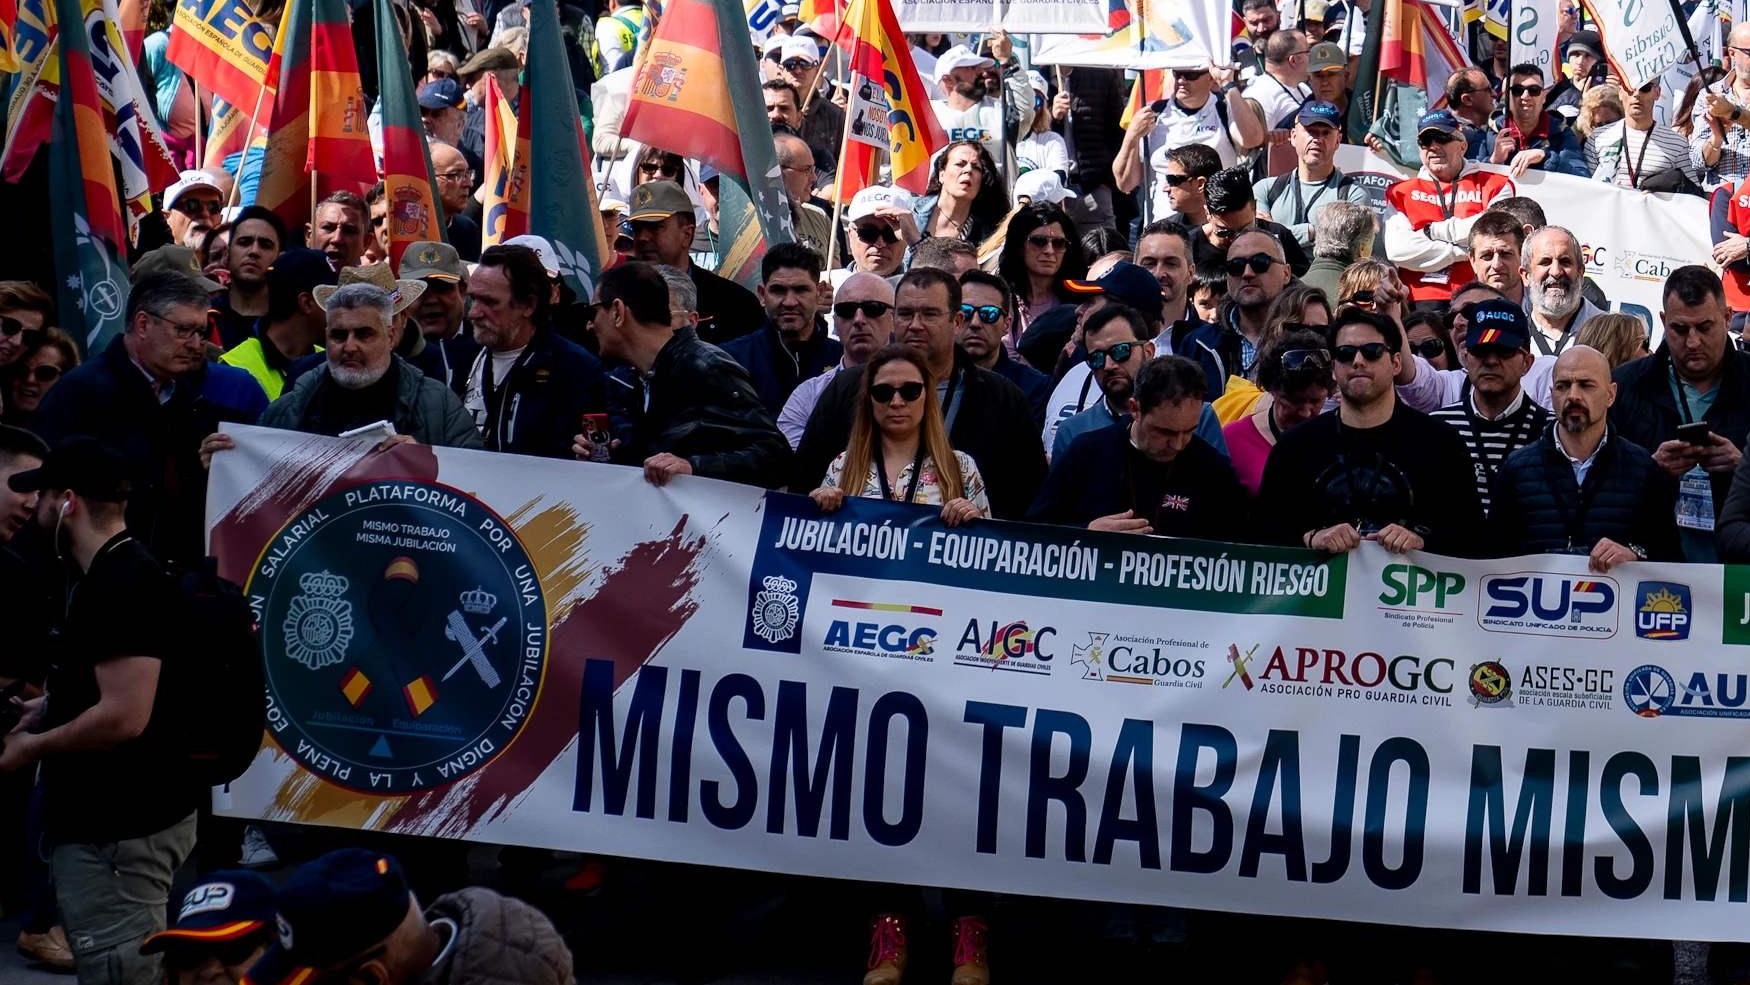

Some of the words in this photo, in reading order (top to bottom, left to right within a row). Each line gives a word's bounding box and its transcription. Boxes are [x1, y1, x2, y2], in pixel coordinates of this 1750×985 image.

[860, 193, 891, 204] AEGC
[1486, 311, 1515, 322] AUGC
[346, 485, 466, 518] PLATAFORMA
[261, 506, 330, 578] SALARIAL
[356, 532, 392, 546] MISMA
[392, 533, 456, 553] JUBILACIÓN
[362, 520, 399, 534] MISMO
[400, 524, 450, 539] TRABAJO
[479, 518, 512, 553] POR
[775, 516, 910, 561] JUBILACIÓN
[928, 530, 1098, 582] EQUIPARACIÓN
[1118, 550, 1246, 594] PROFESIÓN
[1250, 561, 1329, 597] RIESGO
[515, 564, 538, 607] UNA
[1378, 563, 1466, 609] SPP
[1485, 577, 1615, 622] SUP
[1384, 612, 1416, 621] Sindicato
[1416, 614, 1454, 624] Profesional
[1402, 620, 1412, 628] de
[1412, 622, 1435, 630] Policía
[1482, 618, 1524, 628] SINDICATO
[1525, 622, 1566, 632] UNIFICADO
[1637, 612, 1688, 632] UFP
[823, 620, 938, 656] AEGC
[956, 618, 1057, 662] AIGC
[1113, 634, 1154, 645] Asociación
[1156, 638, 1199, 648] Profesional
[1200, 640, 1210, 649] de
[501, 622, 542, 730] JUBILACIÓN
[1107, 646, 1206, 678] Cabos
[1258, 645, 1455, 694] APROGC
[1154, 679, 1184, 688] Guardia
[1185, 680, 1203, 689] Civil
[1260, 682, 1332, 698] ASOCIACIÓN
[1337, 688, 1360, 699] PRO
[1365, 690, 1418, 705] GUARDIA
[1422, 695, 1452, 707] CIVIL
[1518, 688, 1552, 698] asociación
[1552, 691, 1573, 699] escala
[1574, 691, 1612, 701] suboficiales
[1518, 696, 1532, 705] DE
[1533, 696, 1545, 706] LA
[1548, 698, 1588, 709] GUARDIA
[1590, 700, 1612, 710] CIVIL
[296, 738, 352, 780] PLENA
[436, 738, 495, 778] DIGNA
[370, 772, 392, 788] LA
[412, 772, 424, 786] Y
[572, 658, 929, 847] MISMO
[964, 700, 1432, 890] TRABAJO
